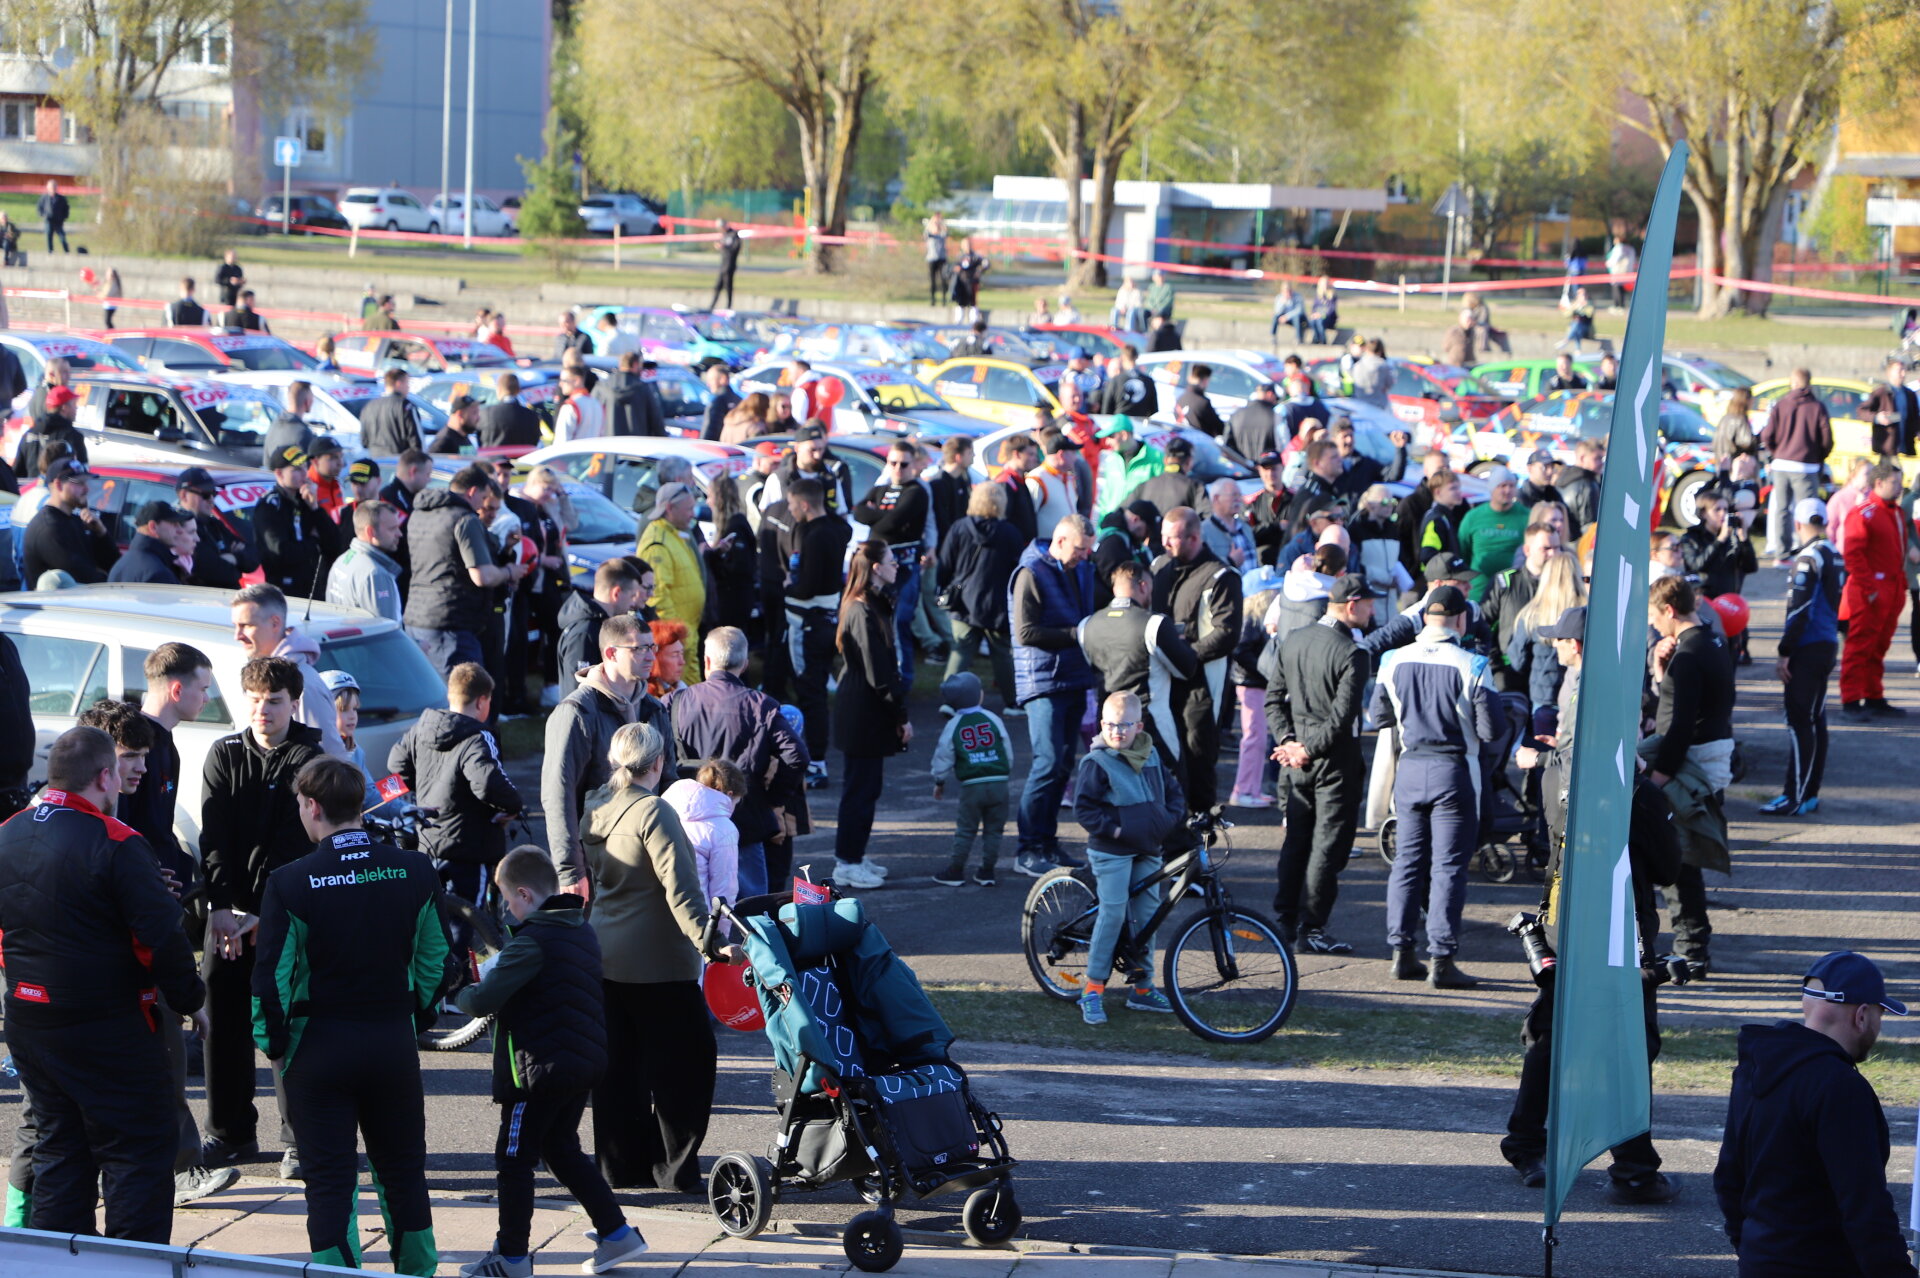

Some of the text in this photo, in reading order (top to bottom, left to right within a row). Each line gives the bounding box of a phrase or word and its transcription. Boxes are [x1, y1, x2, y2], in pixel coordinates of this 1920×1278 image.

[216, 485, 267, 506] TOP
[960, 722, 995, 751] 95
[340, 851, 371, 862] HRX
[308, 866, 408, 889] brandelektra
